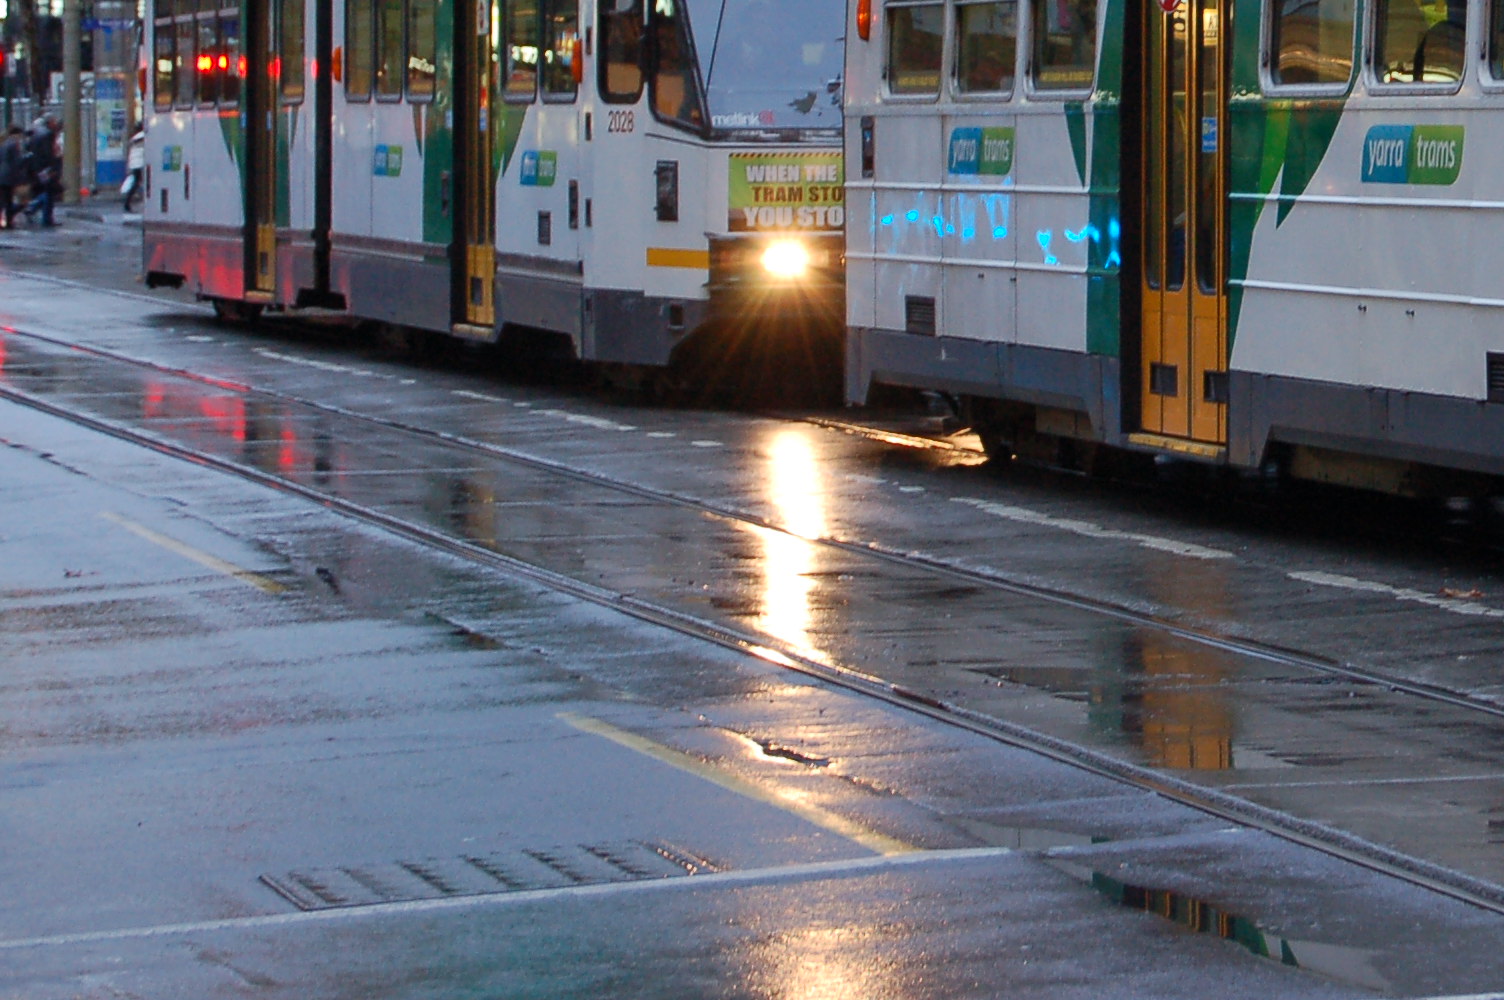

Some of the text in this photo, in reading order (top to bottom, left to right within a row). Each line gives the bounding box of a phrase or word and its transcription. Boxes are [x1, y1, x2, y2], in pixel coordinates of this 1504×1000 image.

[608, 110, 635, 134] 2028
[711, 111, 760, 127] metlink
[1368, 134, 1456, 176] yarra trams
[745, 163, 838, 182] WHEN THE
[752, 185, 803, 203] TRAM
[743, 205, 795, 228] YOU
